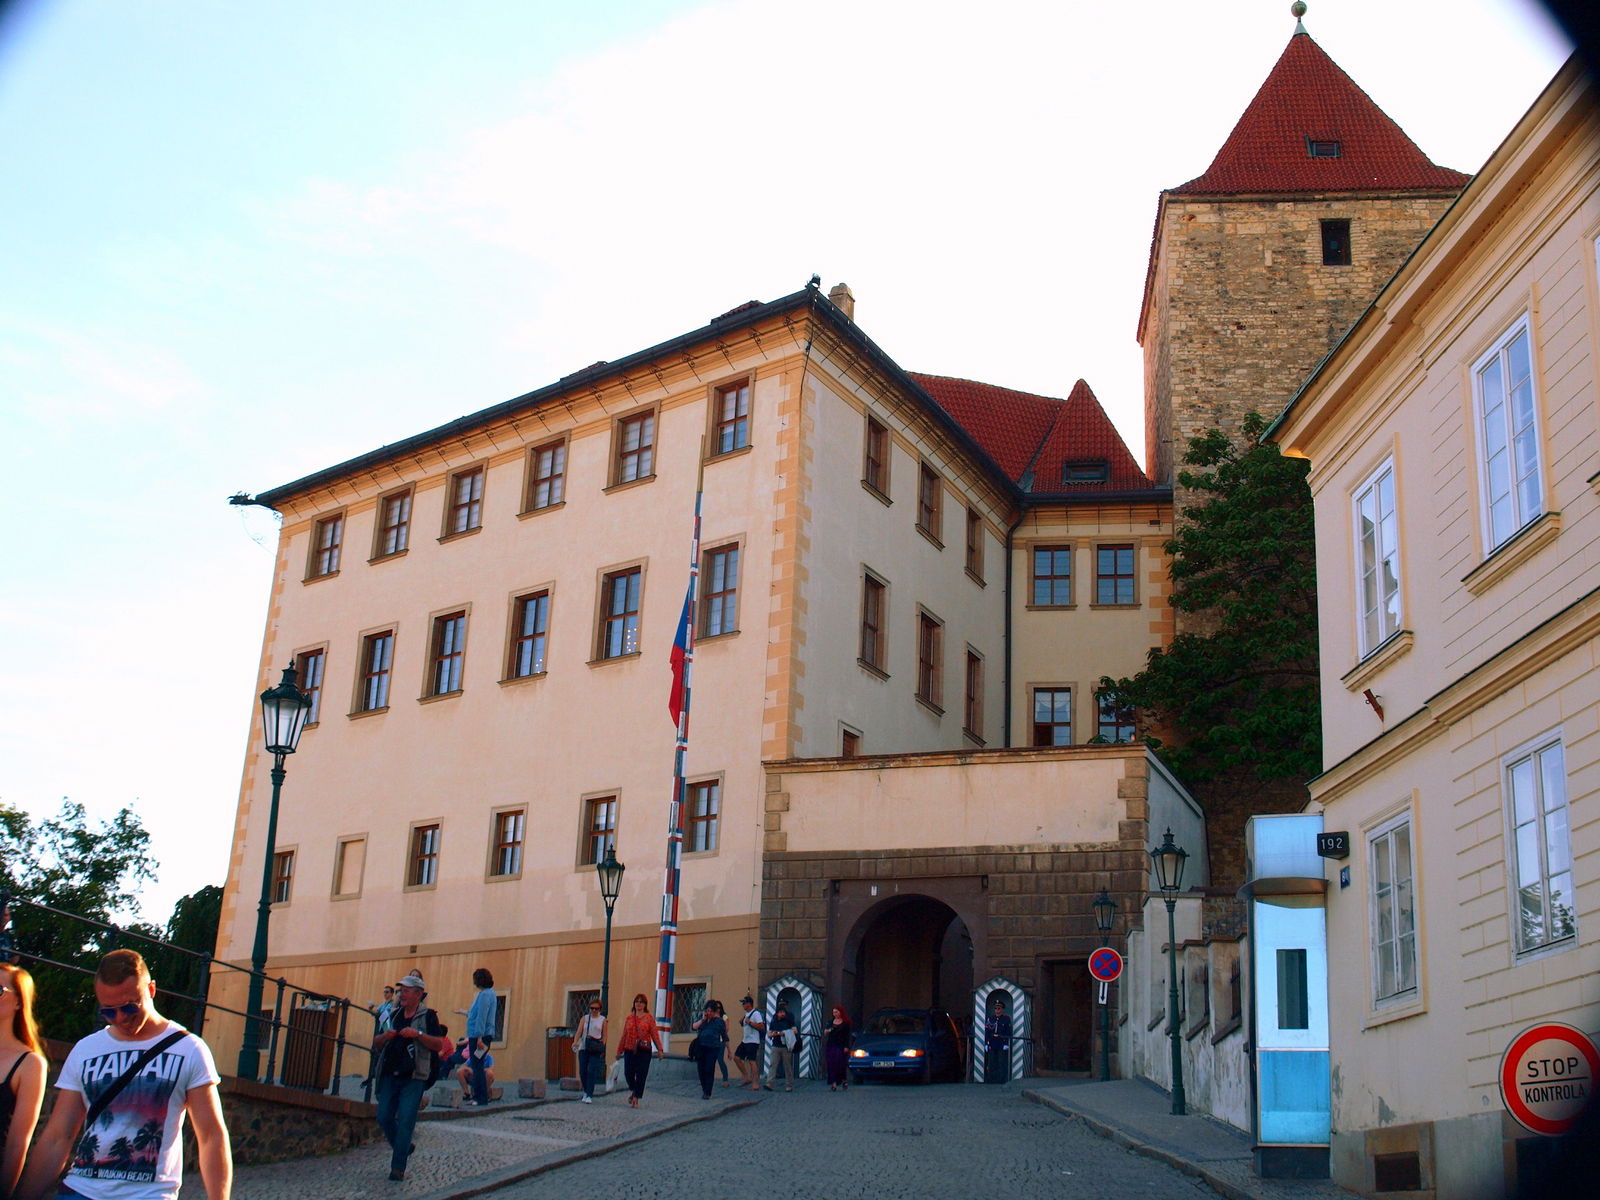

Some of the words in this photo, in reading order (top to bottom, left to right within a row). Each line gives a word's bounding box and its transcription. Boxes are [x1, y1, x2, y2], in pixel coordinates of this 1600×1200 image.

[1321, 837, 1343, 850] 192
[1527, 1056, 1579, 1078] STOP
[1525, 1083, 1585, 1104] KONTROLA
[97, 1168, 127, 1179] WAIKIKI
[126, 1170, 154, 1182] BEACH
